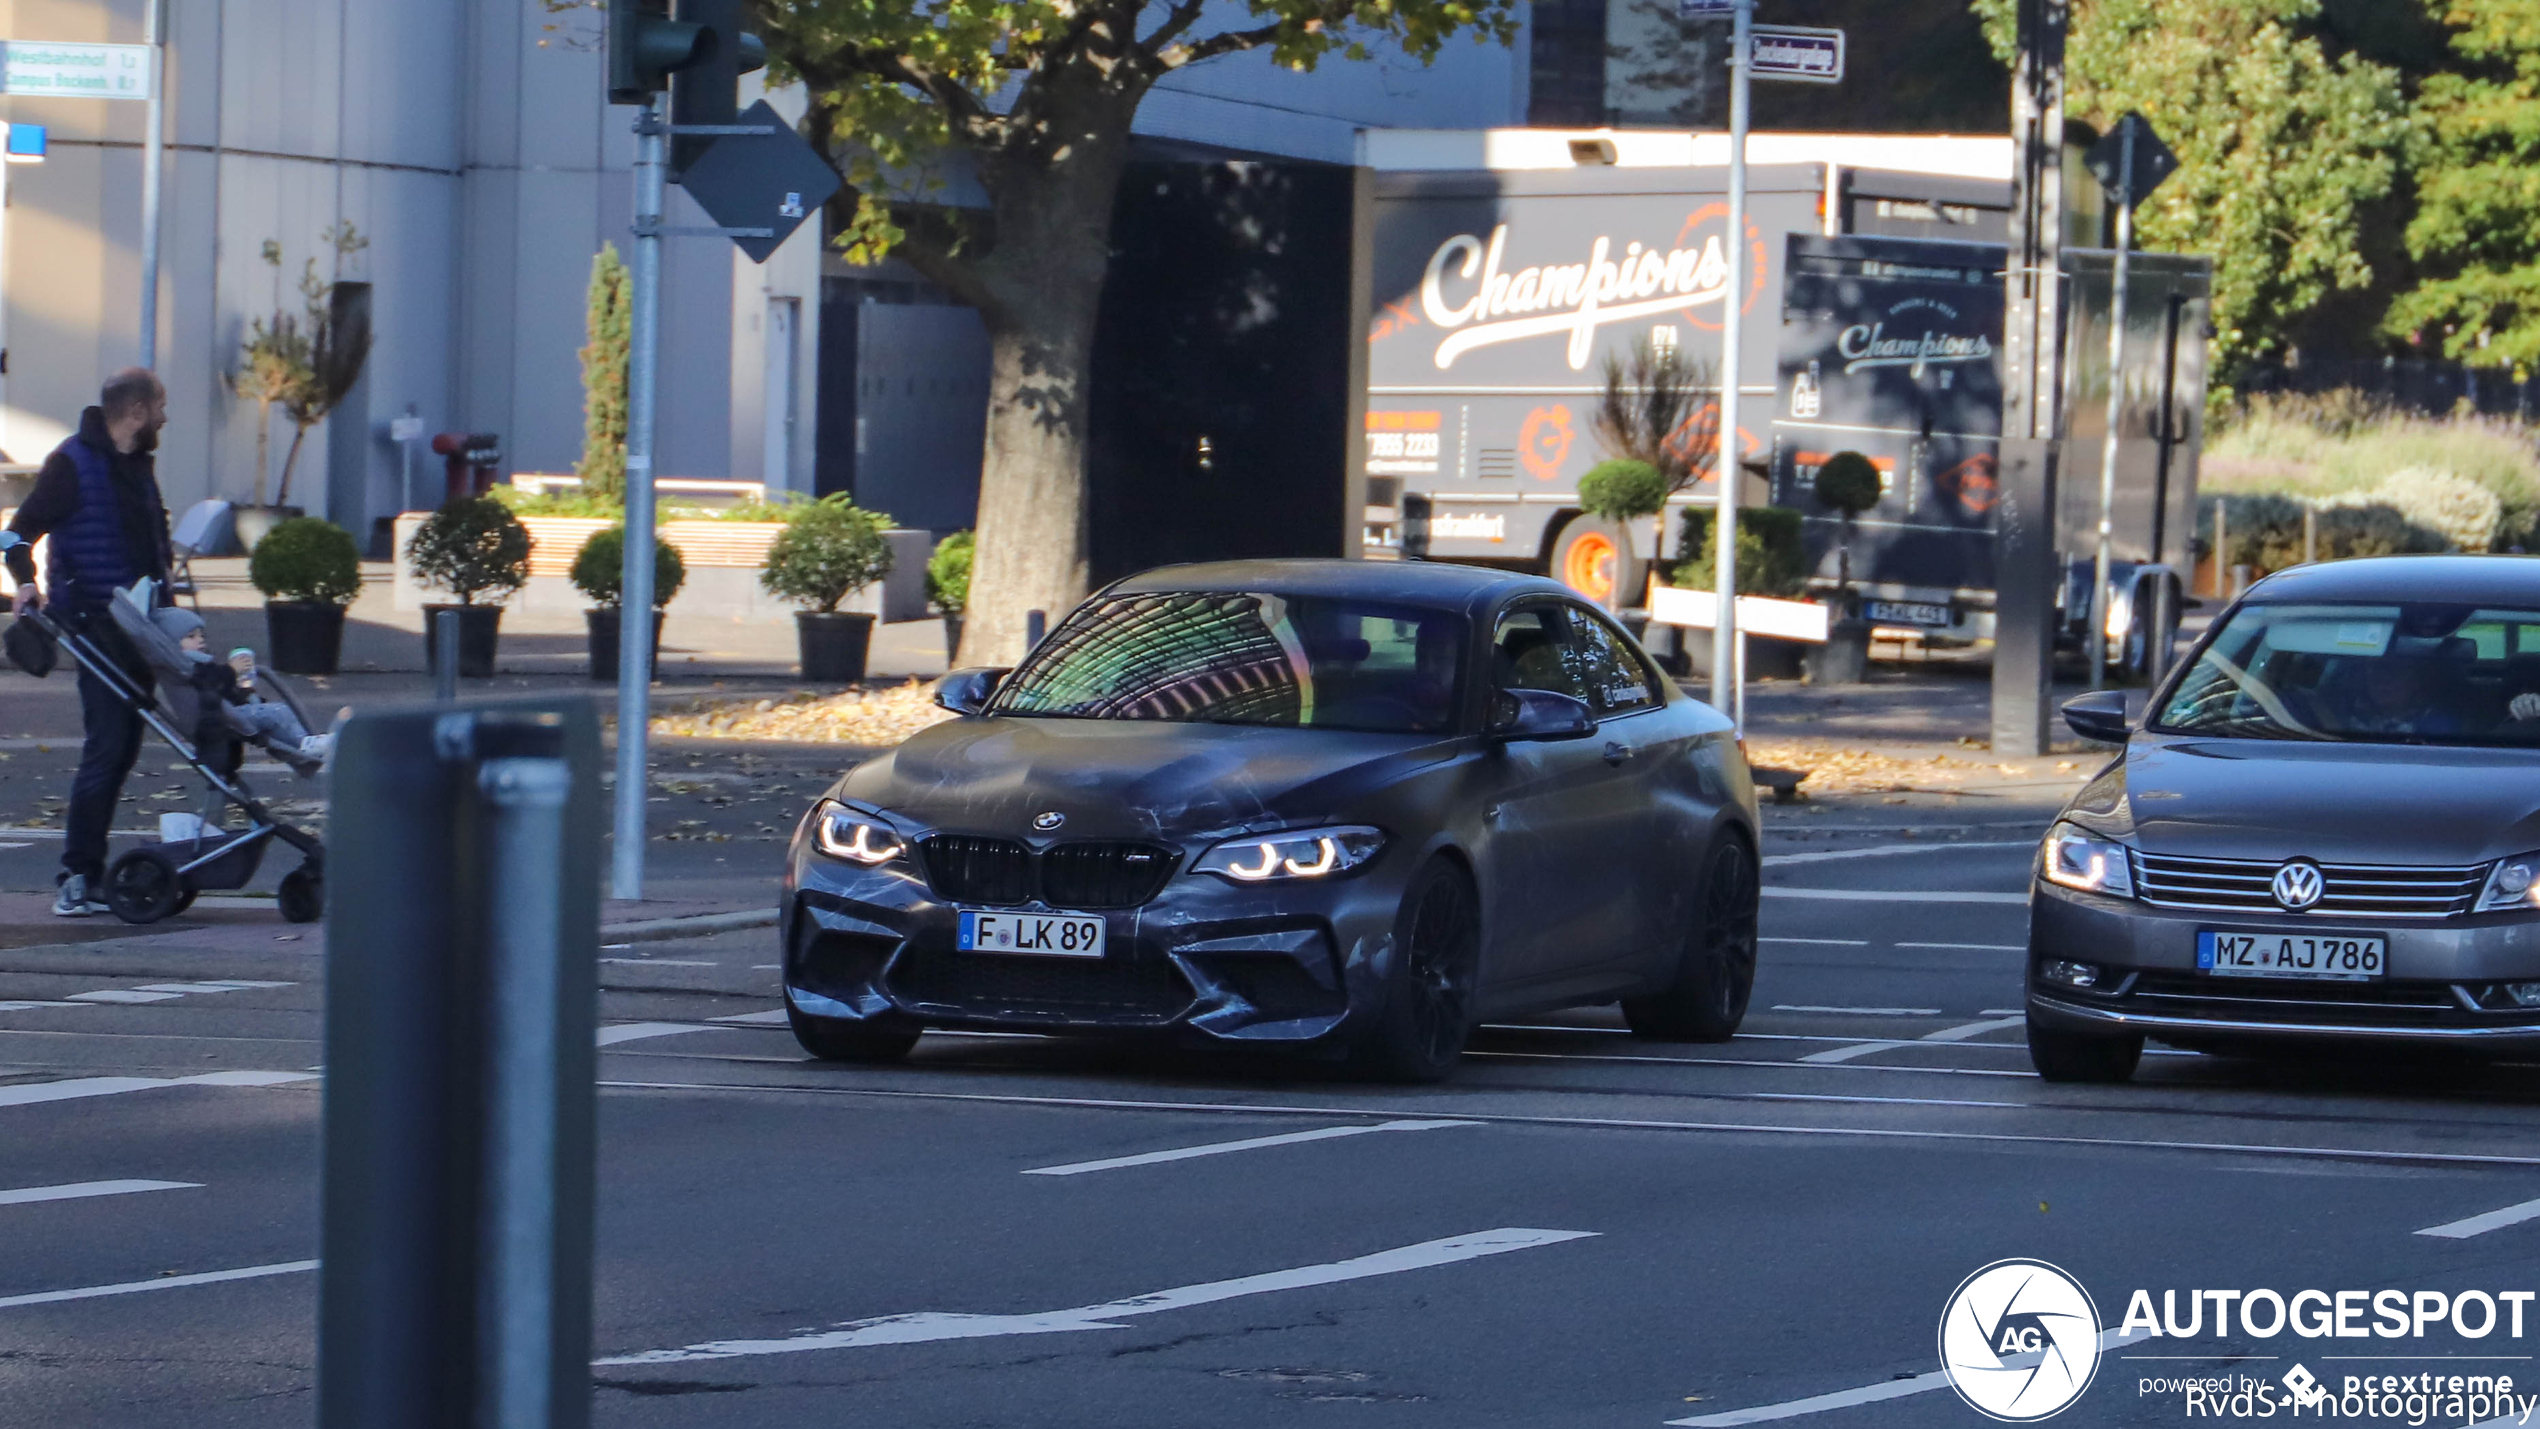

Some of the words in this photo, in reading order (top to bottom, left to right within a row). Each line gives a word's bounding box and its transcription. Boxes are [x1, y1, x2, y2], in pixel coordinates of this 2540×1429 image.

[1423, 224, 1729, 369] Champions
[1838, 322, 1991, 379] Champions
[1405, 433, 1439, 456] 2233
[978, 917, 996, 946] F
[2217, 936, 2255, 966] MZ
[2277, 939, 2315, 968] AJ
[2323, 940, 2378, 970] 786
